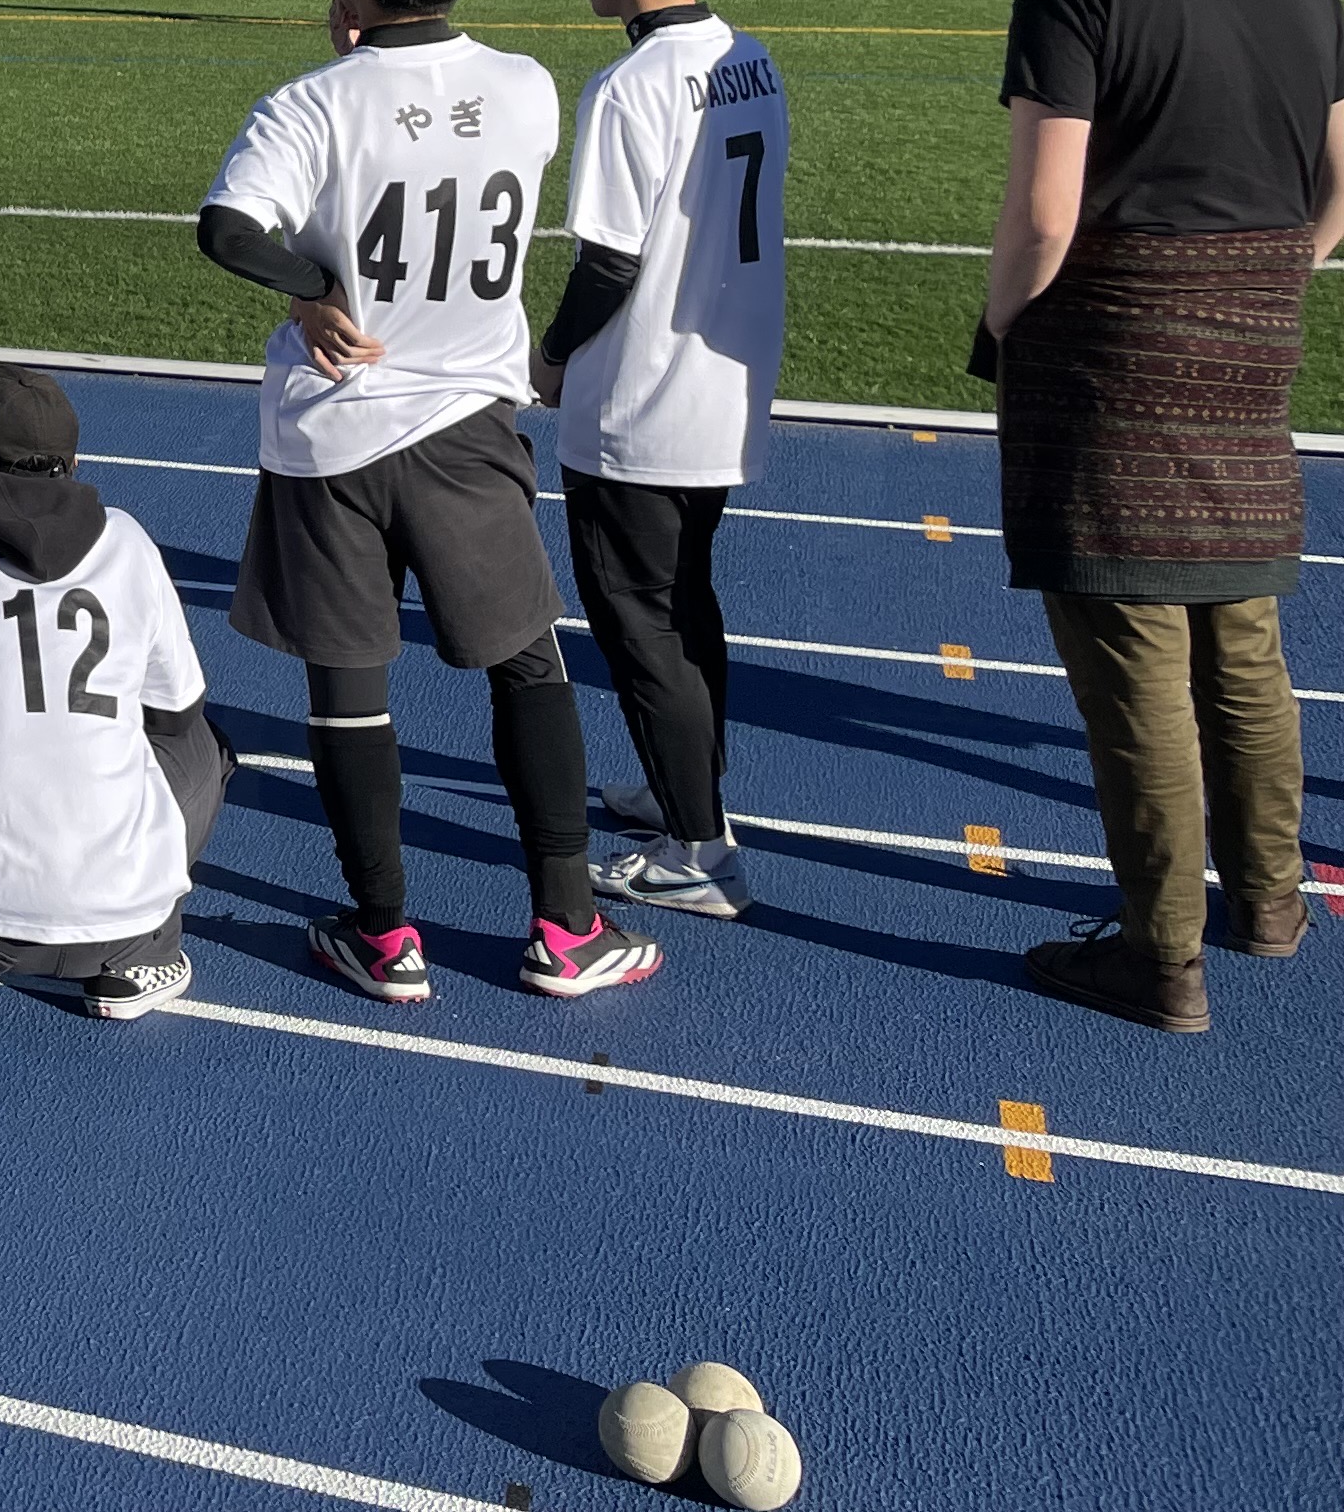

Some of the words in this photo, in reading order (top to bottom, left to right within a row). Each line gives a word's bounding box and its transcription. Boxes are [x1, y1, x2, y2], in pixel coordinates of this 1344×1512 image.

[395, 95, 484, 142] やぎ
[357, 169, 524, 304] 413
[725, 131, 766, 265] 7
